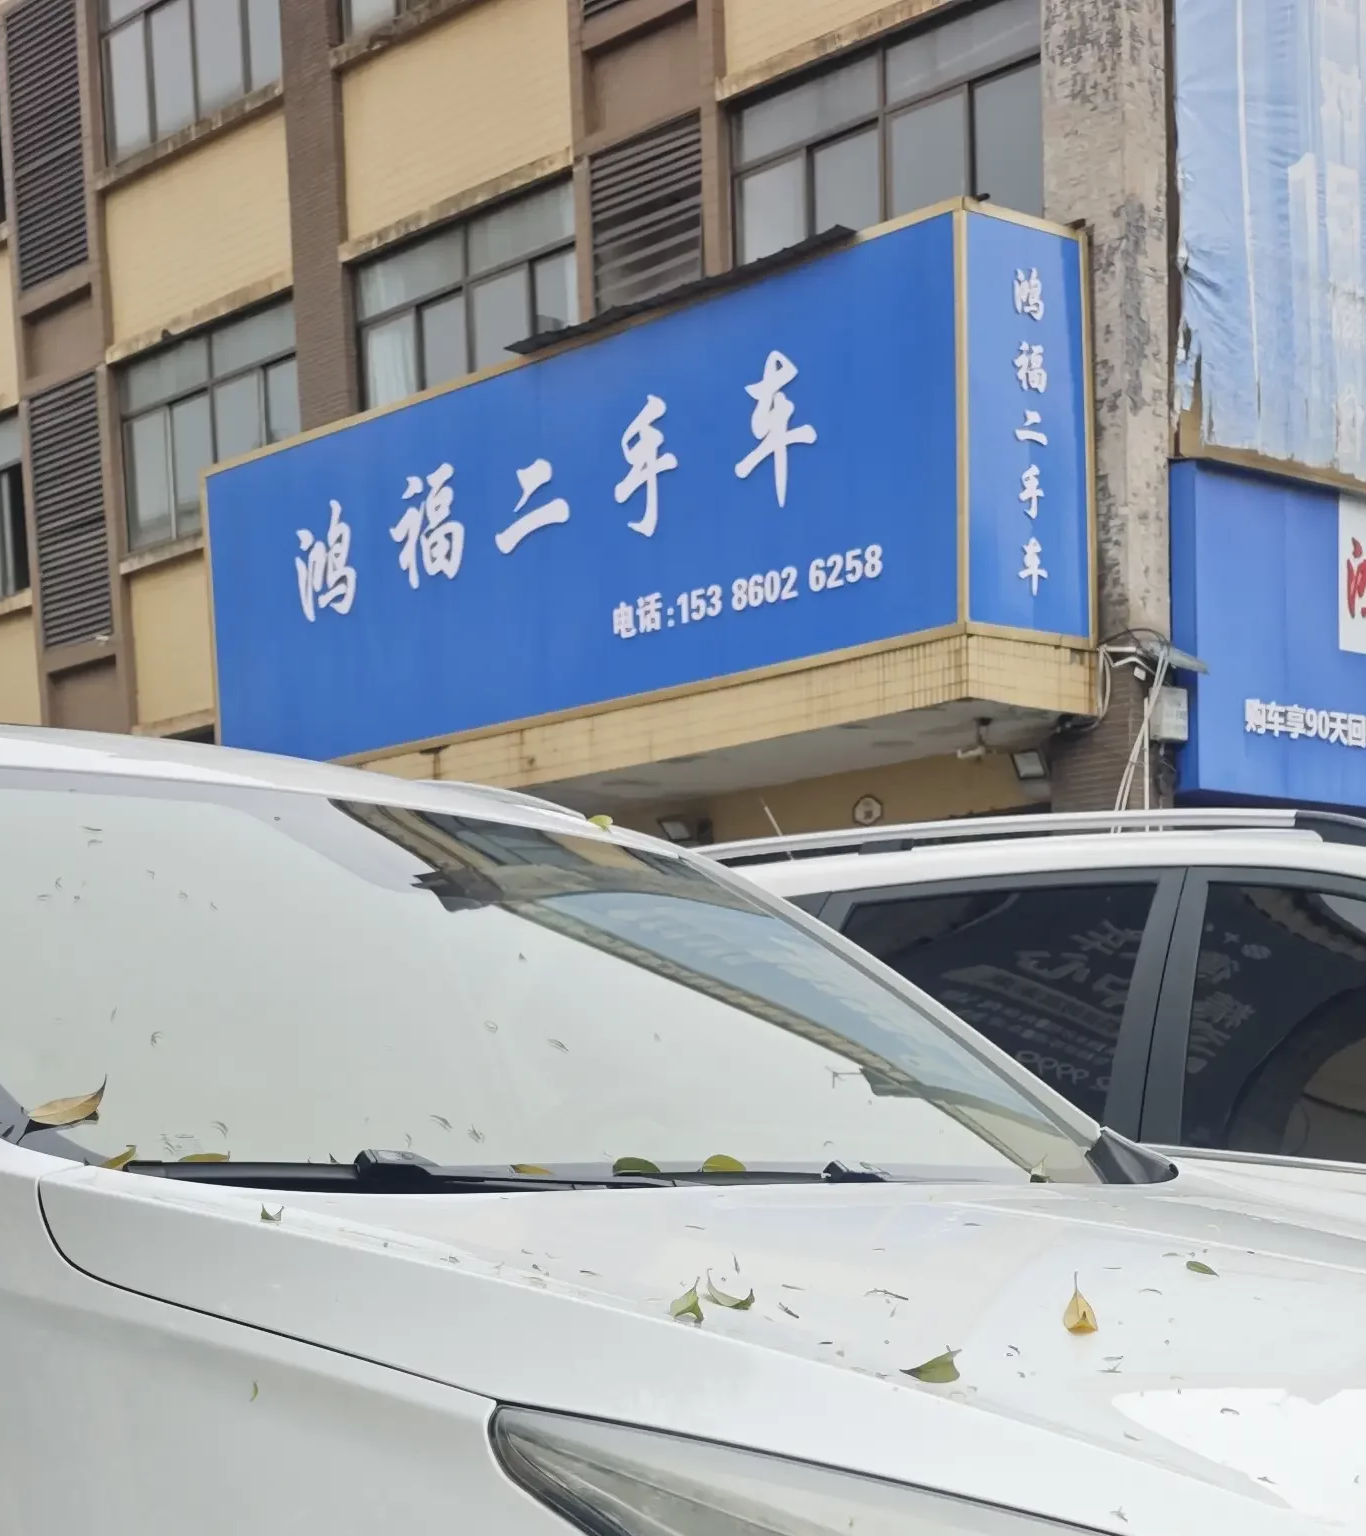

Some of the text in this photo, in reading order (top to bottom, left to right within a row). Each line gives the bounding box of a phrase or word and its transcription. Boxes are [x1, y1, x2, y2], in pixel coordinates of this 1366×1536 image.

[295, 349, 818, 622] 鸿福二手车
[1013, 267, 1049, 596] 鸿福二手车
[732, 566, 799, 612] 8602
[808, 543, 884, 594] 6258
